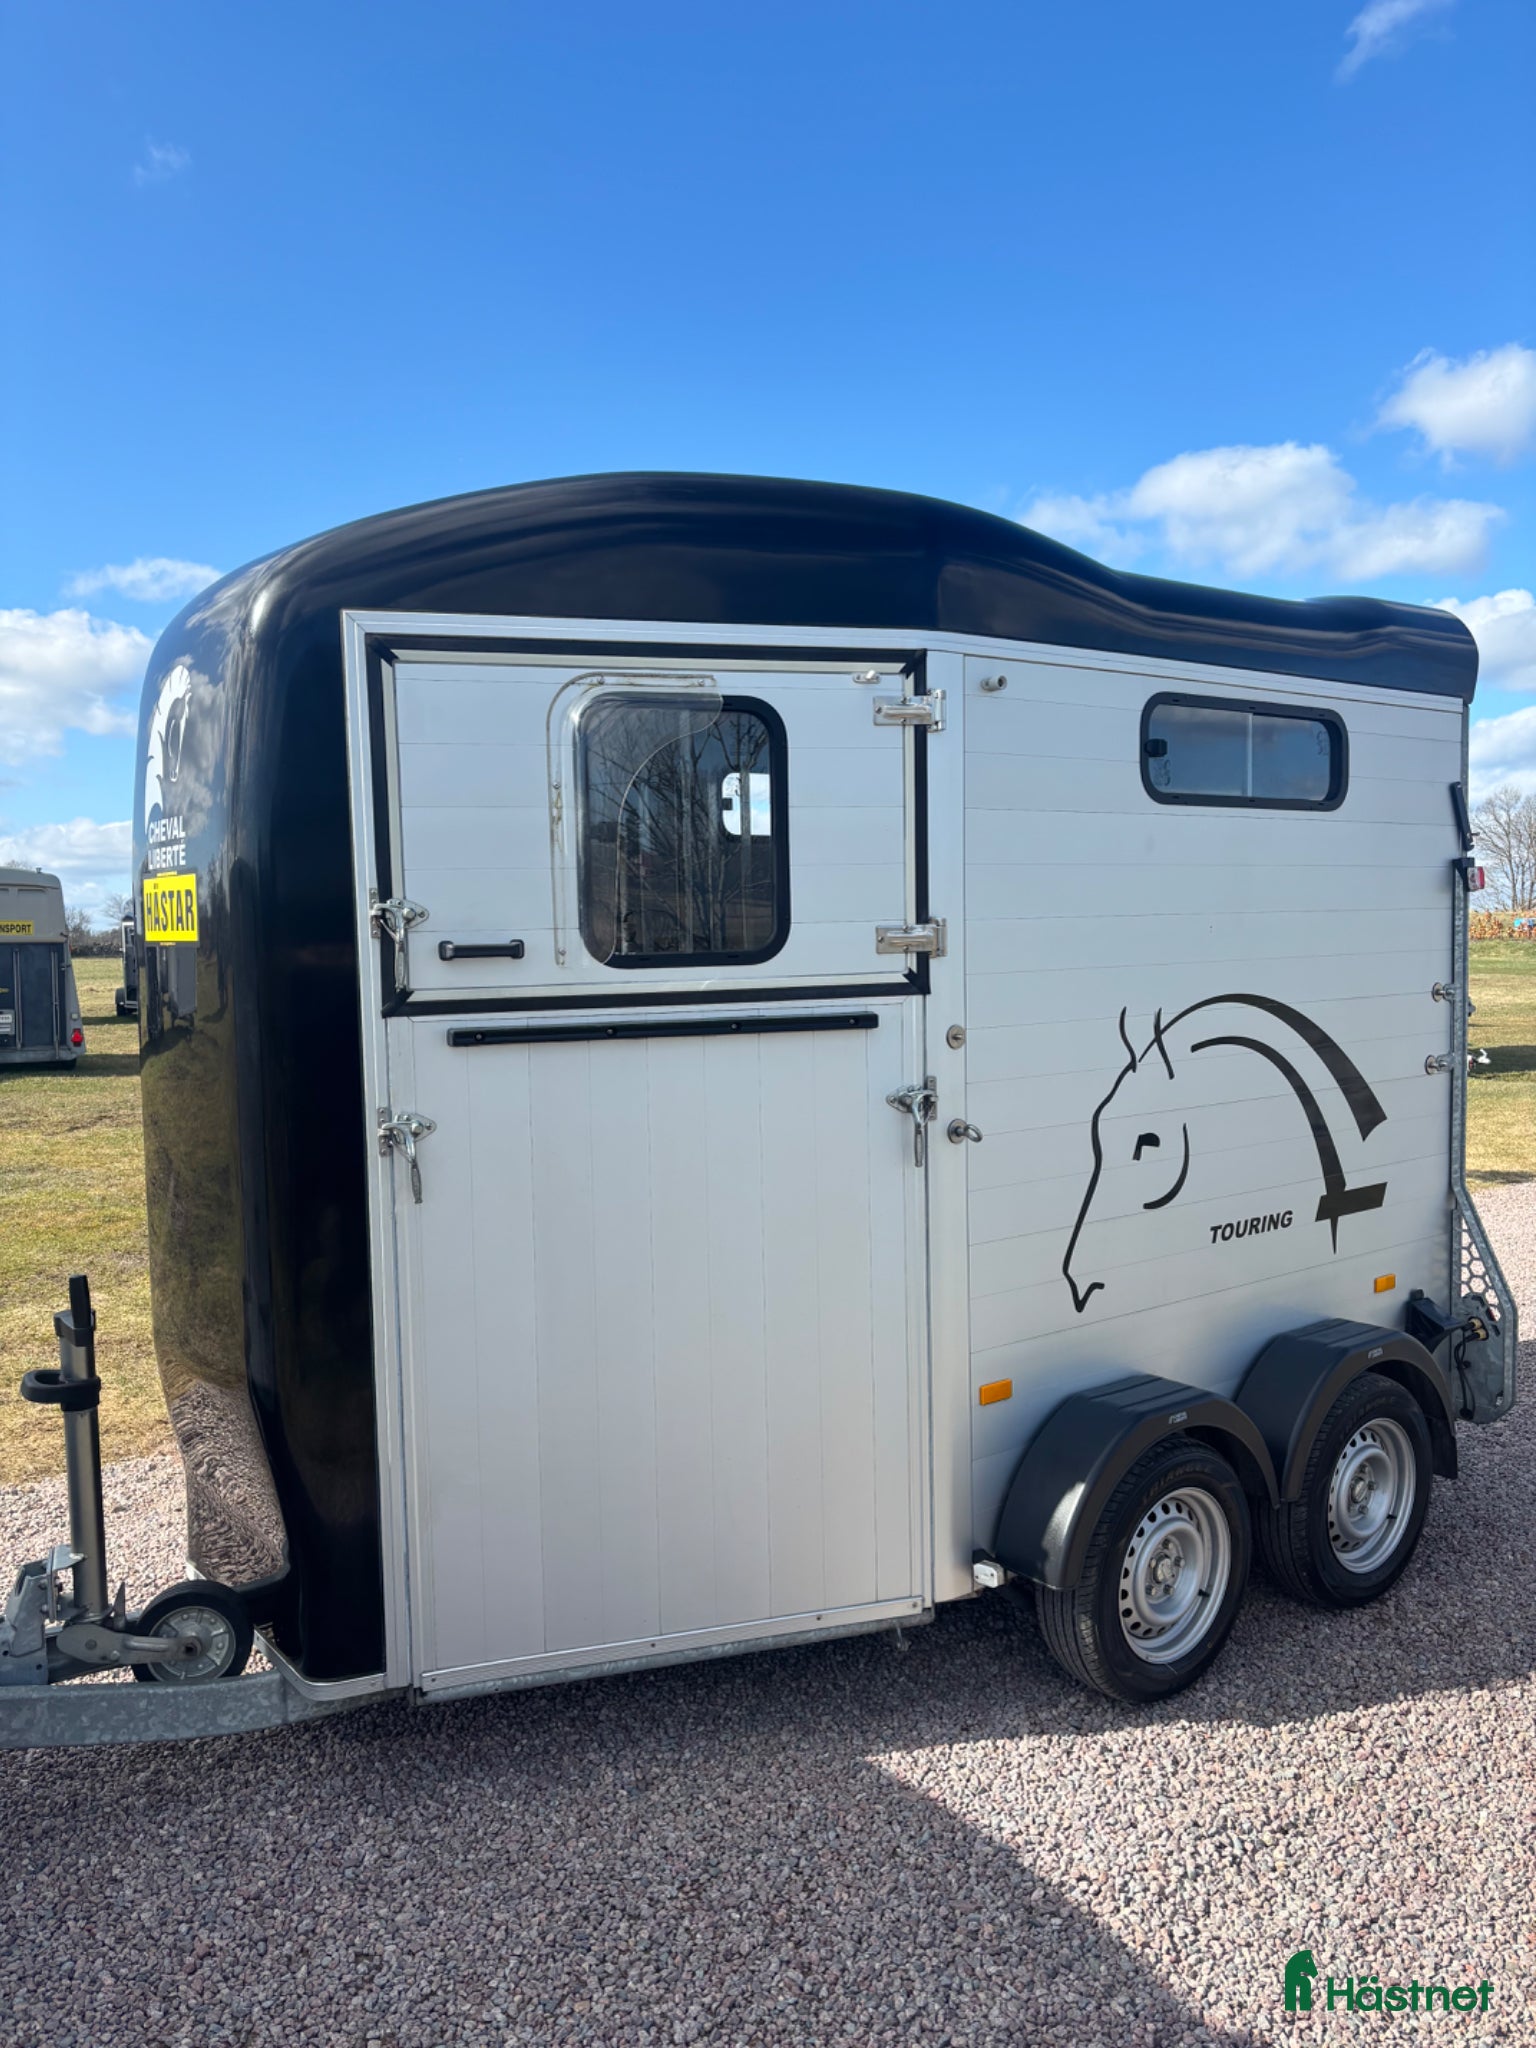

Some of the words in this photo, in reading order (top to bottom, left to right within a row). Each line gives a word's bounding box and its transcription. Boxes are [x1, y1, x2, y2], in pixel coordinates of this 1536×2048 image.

[148, 816, 186, 844] CHEVAL
[147, 839, 186, 870] LIBERTÉ
[146, 883, 195, 932] HÄSTAR
[1209, 1210, 1294, 1244] TOURING
